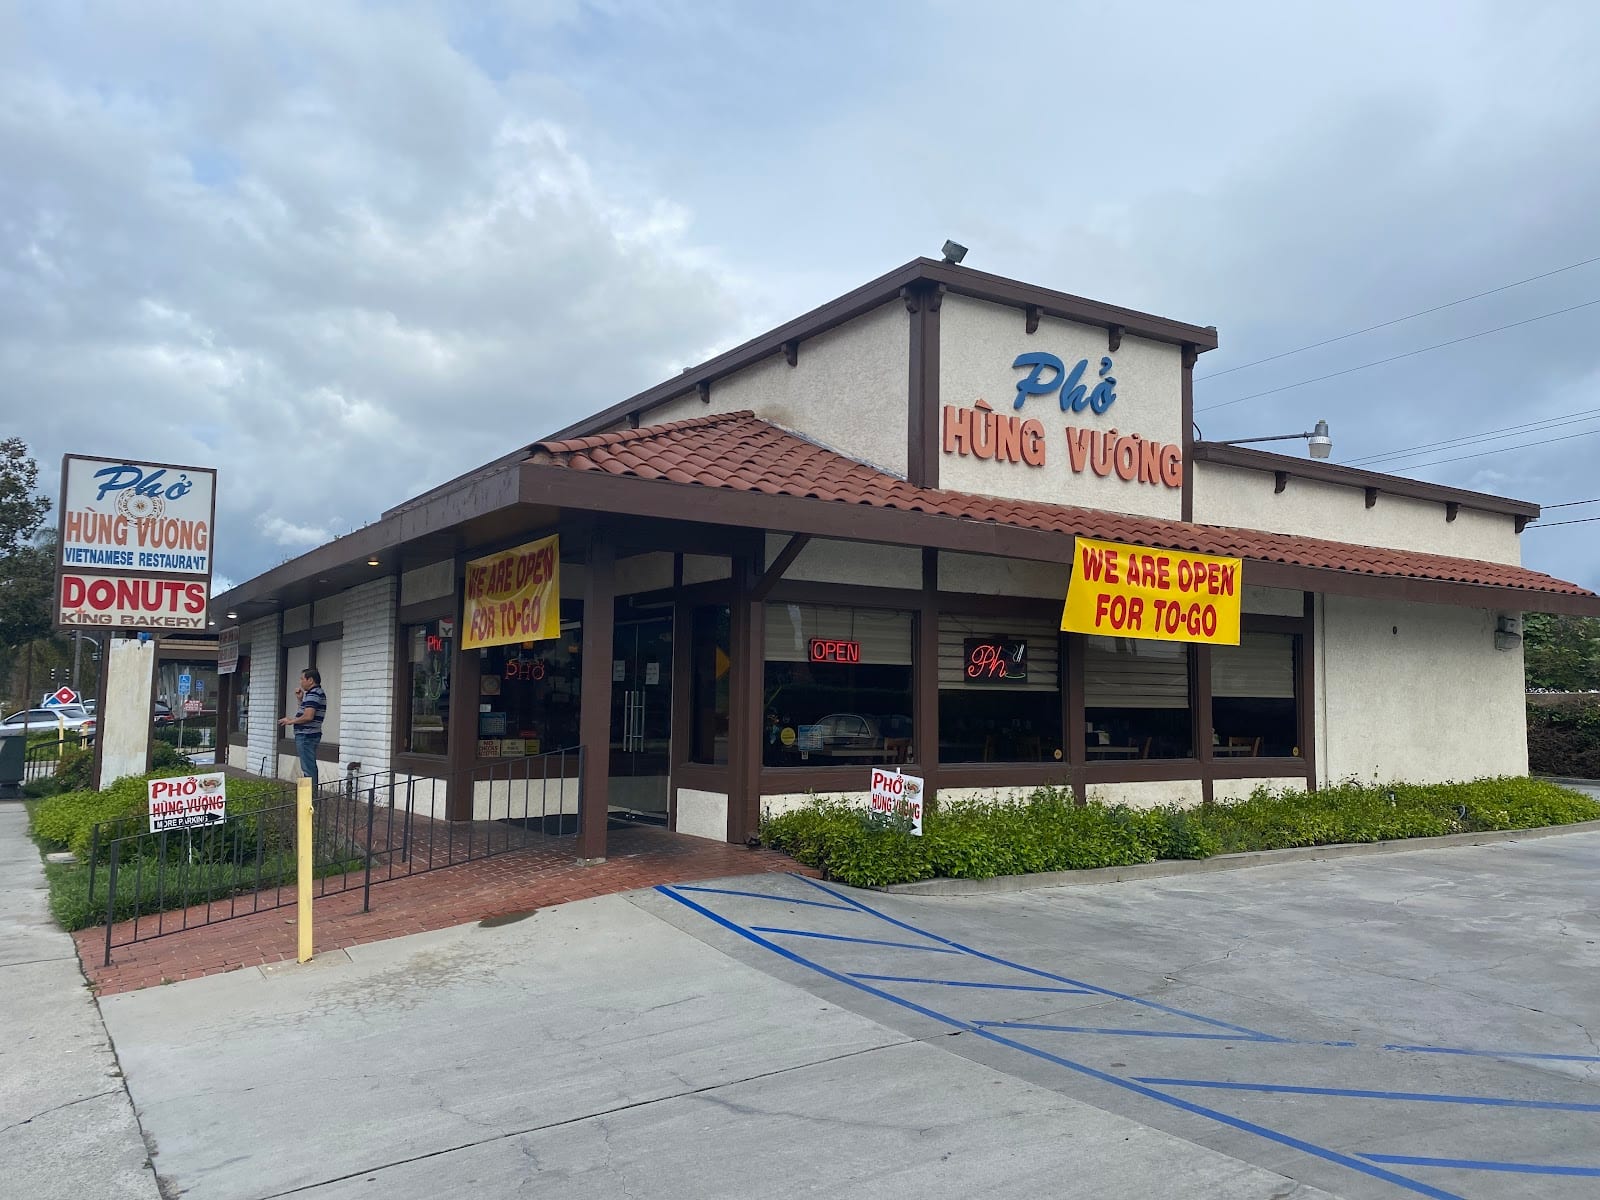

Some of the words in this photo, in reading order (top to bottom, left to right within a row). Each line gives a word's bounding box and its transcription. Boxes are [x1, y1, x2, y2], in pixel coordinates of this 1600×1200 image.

[1012, 352, 1117, 415] Phở
[943, 398, 1045, 467] HÙNG
[1065, 427, 1182, 488] VƯƠNG
[93, 465, 193, 500] Phở
[66, 507, 128, 546] HÙNG
[137, 516, 207, 551] VƯƠNG
[65, 548, 134, 565] VIETNAMESE
[139, 552, 206, 570] RESTAURANT
[468, 566, 487, 600] WE
[487, 557, 514, 595] ARE
[516, 543, 553, 590] OPEN
[1082, 547, 1119, 584] WE
[1126, 553, 1171, 590] ARE
[1177, 559, 1235, 597] OPEN
[62, 576, 205, 614] DONUTS
[1094, 593, 1144, 631] FOR
[1153, 599, 1217, 637] TO-GO
[61, 611, 112, 625] KING
[121, 614, 202, 627] BAKERY
[470, 605, 495, 641] FOR
[500, 596, 540, 637] TO-GO
[812, 641, 859, 663] OPEN
[156, 819, 177, 829] MORE
